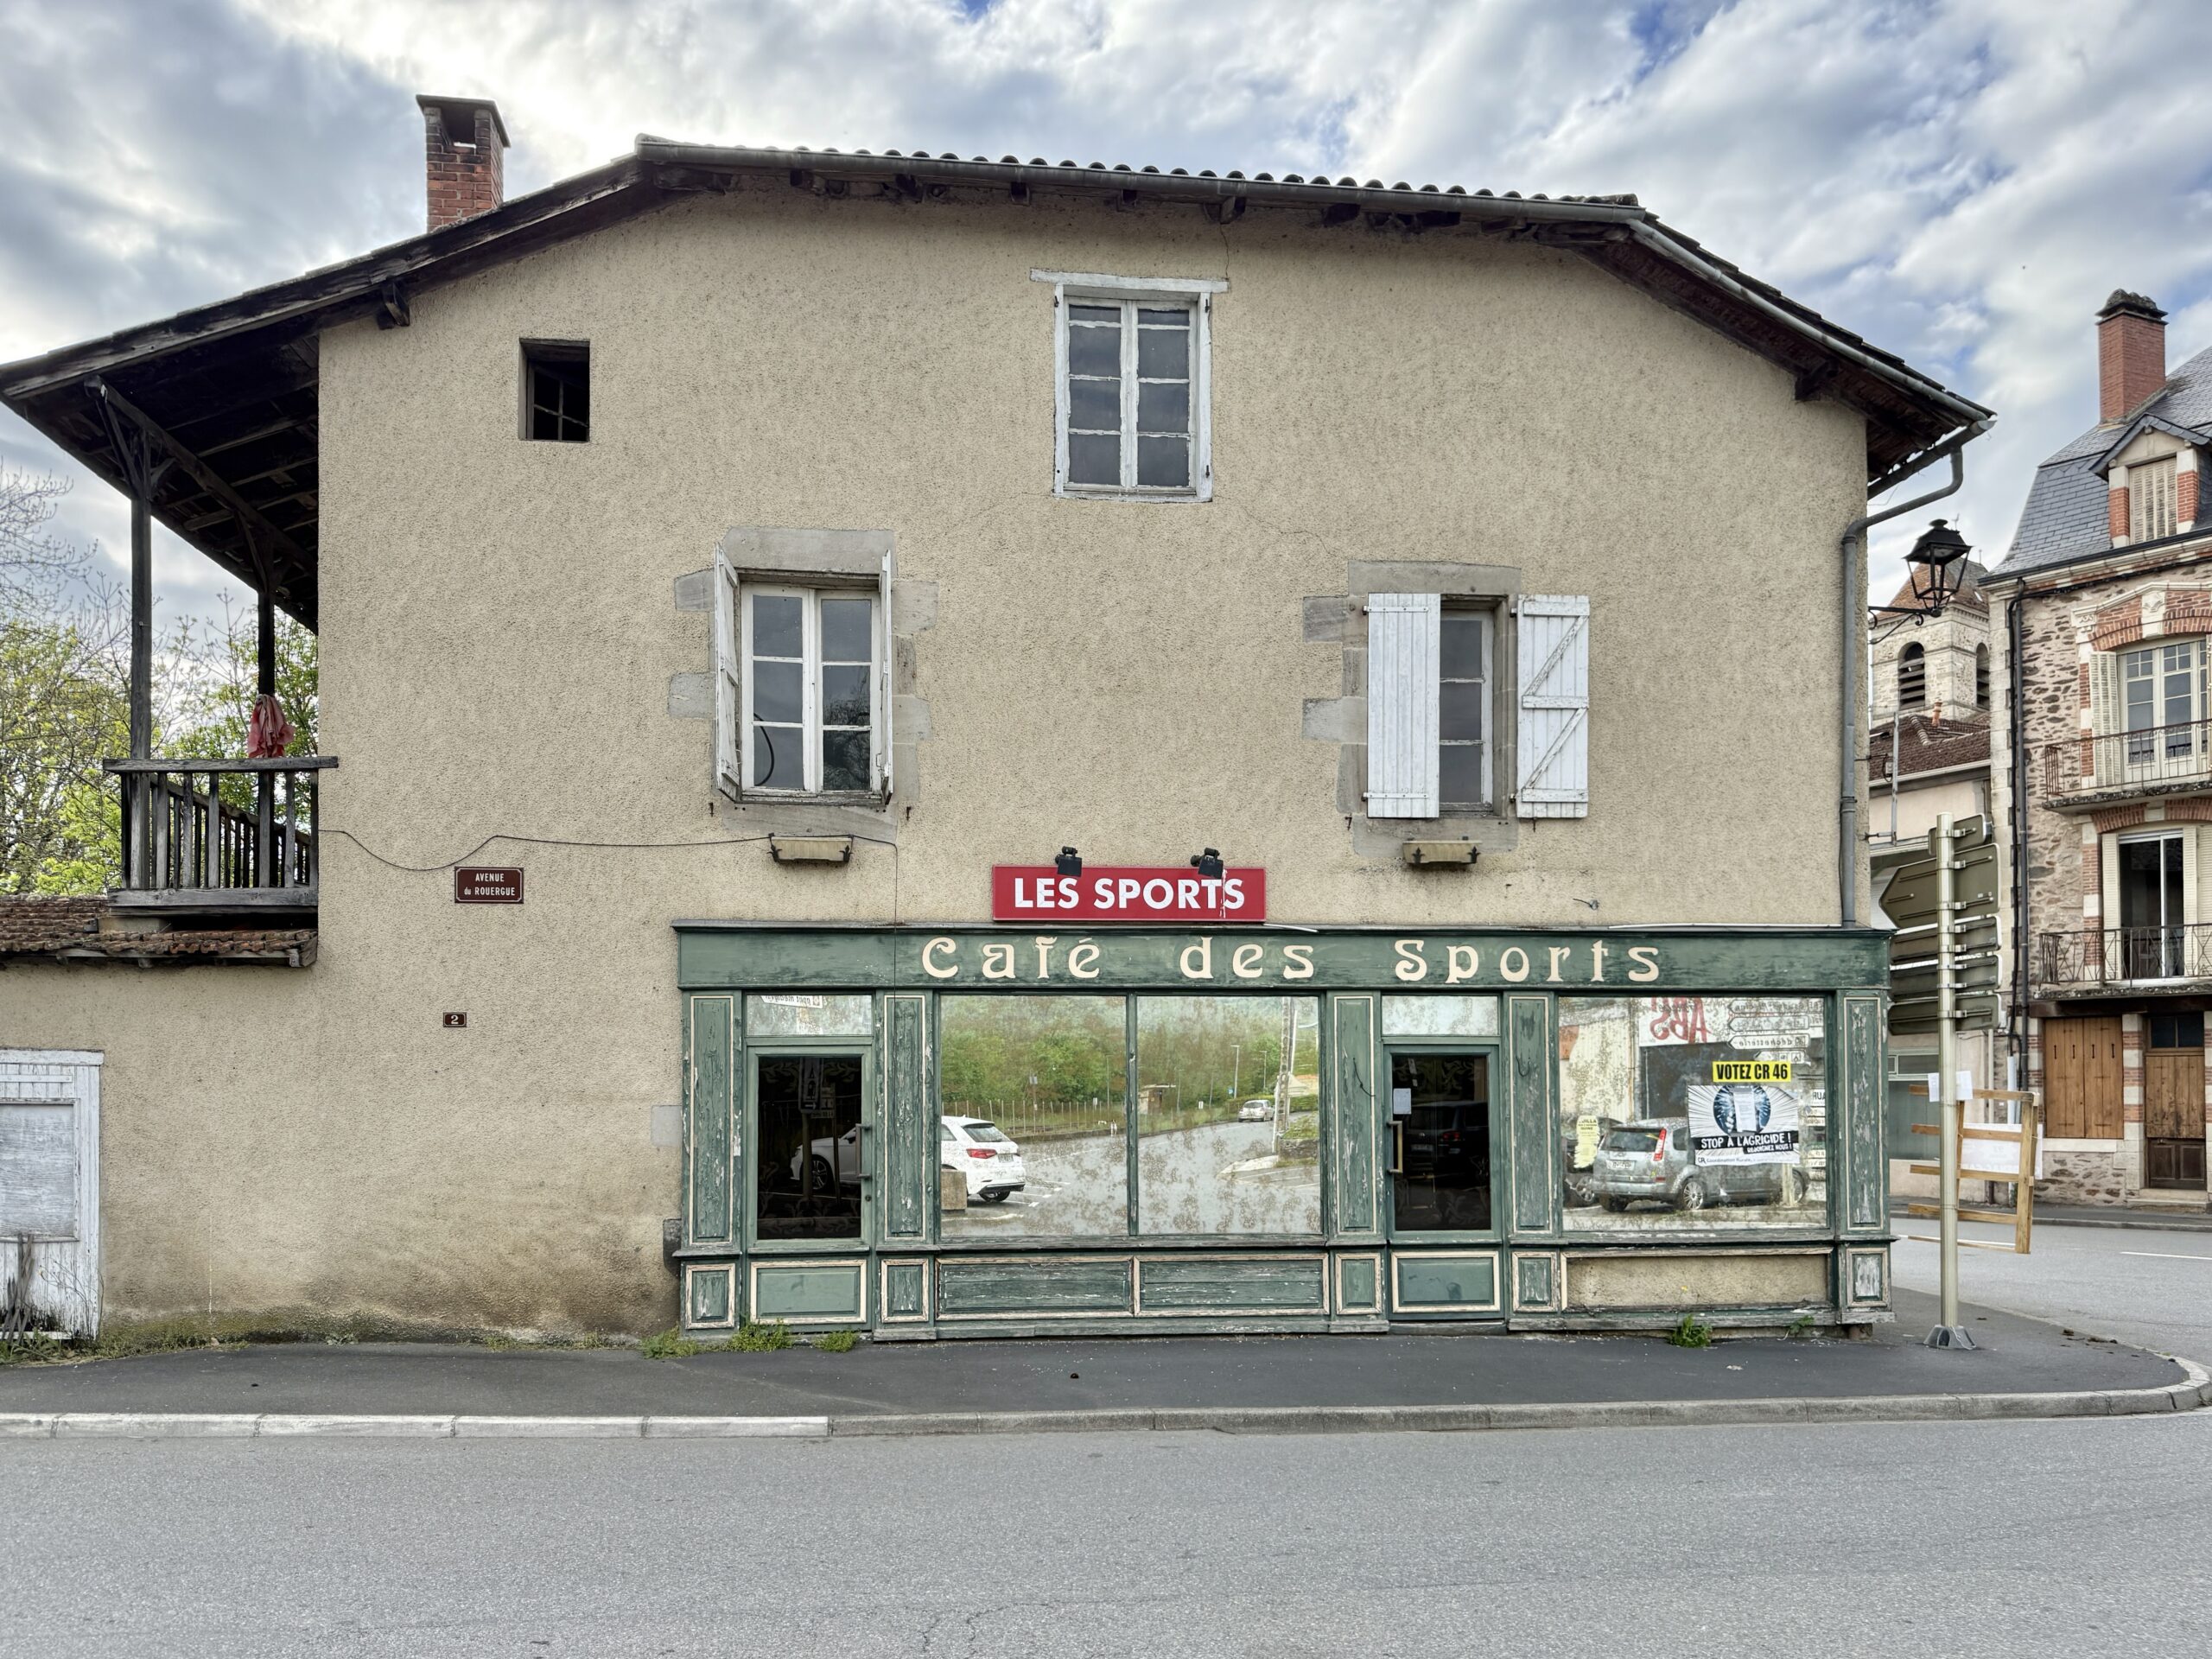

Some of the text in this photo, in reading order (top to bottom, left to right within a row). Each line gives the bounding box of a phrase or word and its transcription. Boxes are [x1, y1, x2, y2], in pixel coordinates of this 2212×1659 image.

[475, 873, 505, 882] AVENUE
[474, 887, 515, 896] ROUERGUE
[1014, 877, 1245, 909] LES SPORTS
[921, 937, 1659, 984] Café des Sports
[450, 1015, 459, 1024] 2
[1716, 1064, 1788, 1079] VOTEZ CR 46
[1700, 1137, 1724, 1149] STOP
[1737, 1134, 1785, 1146] L'AGRICIDE
[1746, 1145, 1774, 1154] REJOIGNEZ
